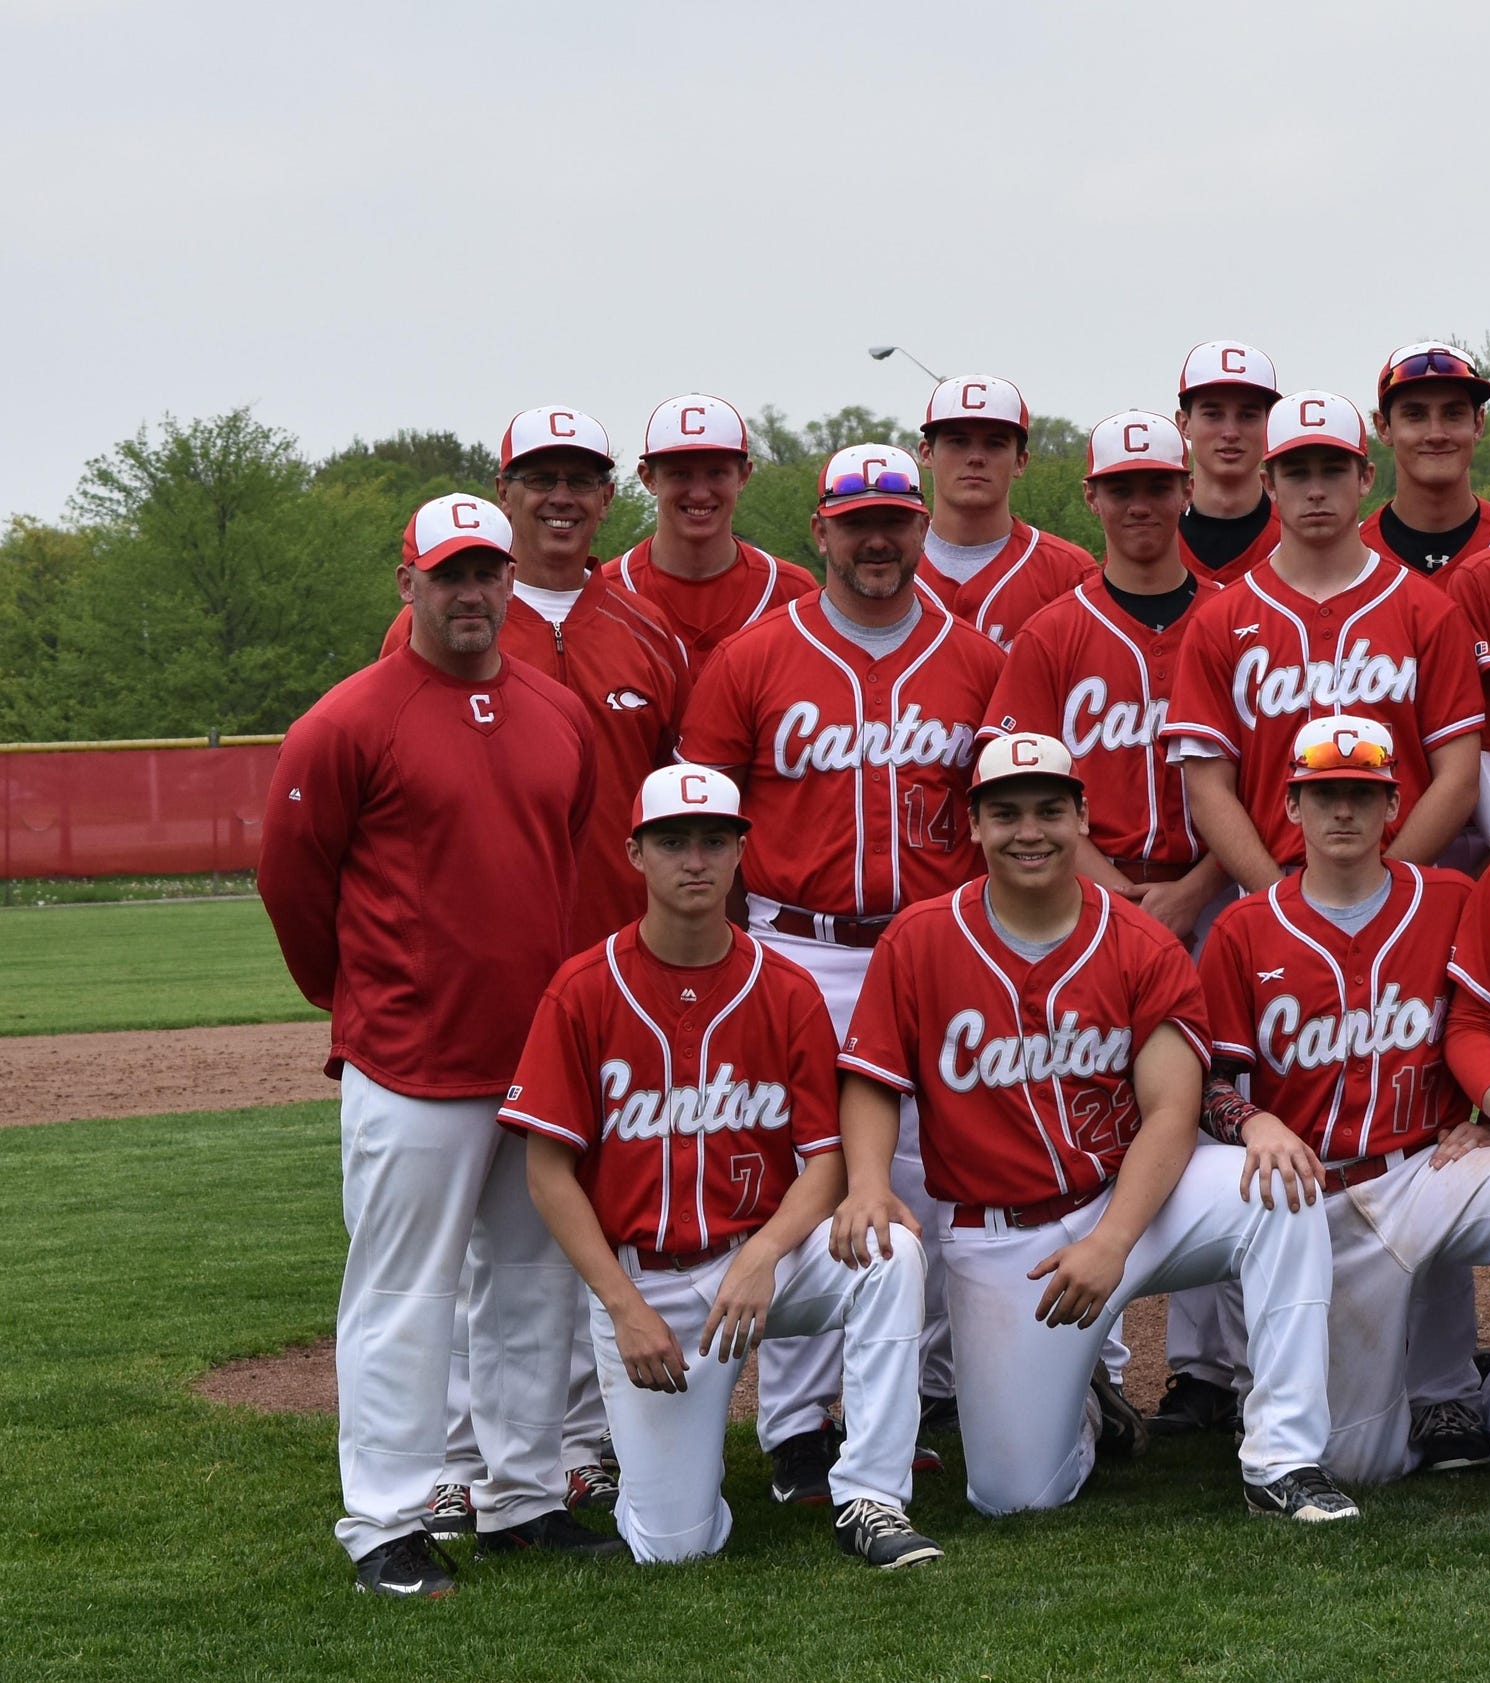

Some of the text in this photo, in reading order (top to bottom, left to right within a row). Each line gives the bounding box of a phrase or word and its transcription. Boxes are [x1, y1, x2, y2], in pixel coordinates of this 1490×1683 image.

[1221, 348, 1246, 374] C
[961, 384, 986, 410] C
[549, 412, 576, 437] C
[680, 407, 705, 435] C
[1299, 399, 1326, 427] C
[1123, 424, 1150, 453] C
[863, 459, 886, 487] C
[452, 503, 480, 529] C
[1232, 645, 1417, 731] Canton
[469, 694, 494, 722] C
[1062, 676, 1170, 758] Can
[774, 700, 976, 780] Canton
[1011, 740, 1039, 767] C
[680, 775, 708, 804] C
[905, 784, 957, 853] 14
[939, 1008, 1132, 1093] Canton
[600, 1058, 790, 1143] Canton
[729, 1153, 765, 1219] 7
